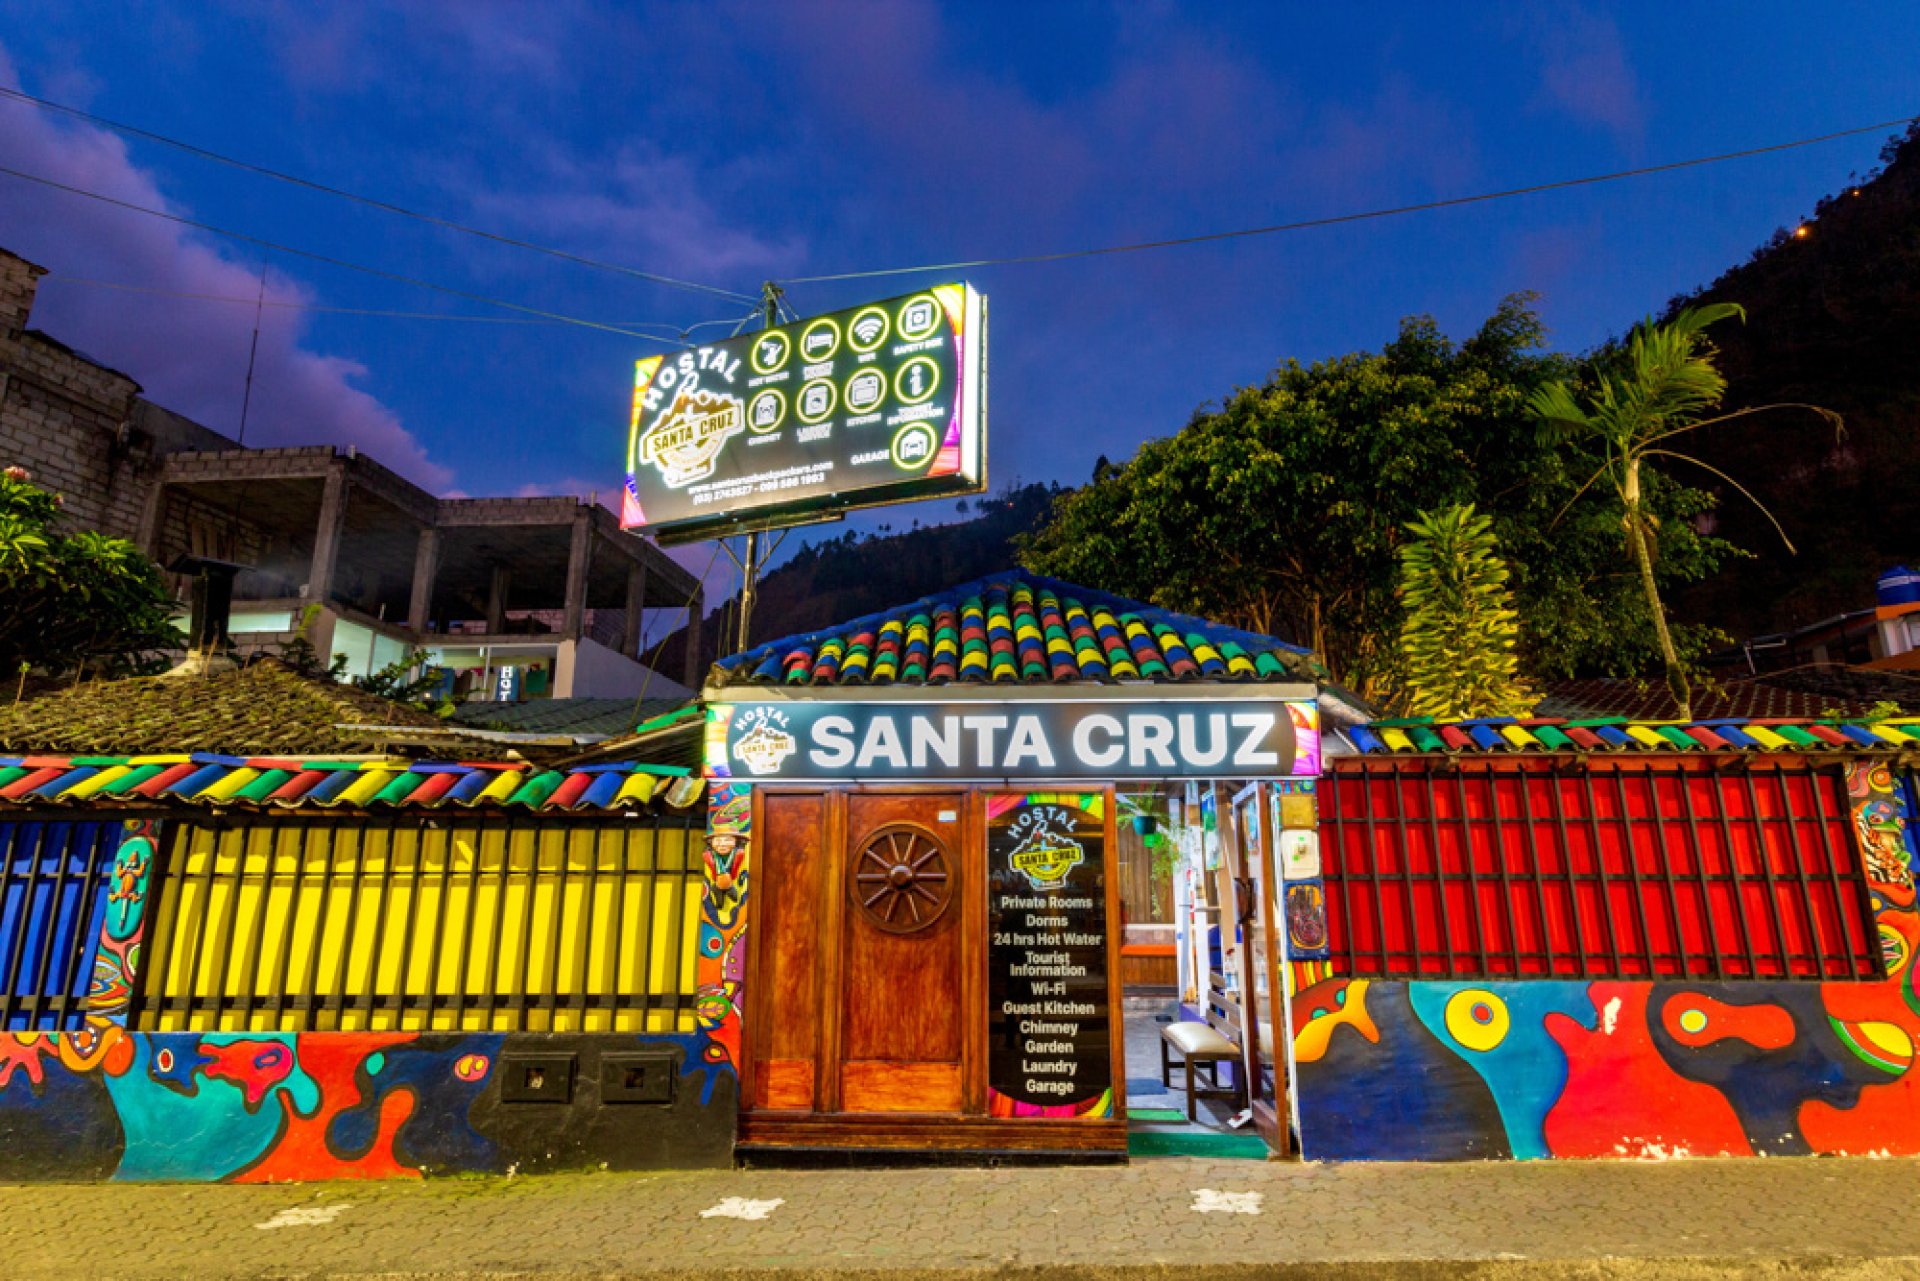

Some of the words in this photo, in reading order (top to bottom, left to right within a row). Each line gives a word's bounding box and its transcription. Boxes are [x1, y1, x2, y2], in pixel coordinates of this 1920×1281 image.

[643, 347, 741, 411] HOSTAL
[652, 424, 694, 453] SANTA
[700, 411, 734, 436] CRUZ
[850, 448, 890, 466] GARAGE
[735, 706, 790, 731] HOSTAL
[808, 714, 1056, 769] SANTA
[1072, 712, 1278, 768] CRUZ
[1007, 806, 1078, 838] HOSTAL
[1018, 852, 1049, 866] SANTA
[1001, 895, 1046, 909] Private
[1048, 895, 1093, 909] Rooms
[1026, 914, 1069, 927] Dorms
[994, 933, 1011, 946] 24
[1013, 933, 1035, 946] hrs
[1036, 933, 1061, 946] Hot
[1062, 933, 1103, 946] Water
[1025, 951, 1070, 965] Tourist
[1010, 964, 1087, 977] Information
[1031, 981, 1067, 995] Wi-Fi
[1003, 1001, 1042, 1015] Guest
[1044, 1001, 1096, 1015] Kitchen
[1019, 1020, 1079, 1037] Chimney
[1025, 1040, 1074, 1053] Garden
[1022, 1060, 1078, 1076] Laundry
[1026, 1079, 1075, 1096] Garage
